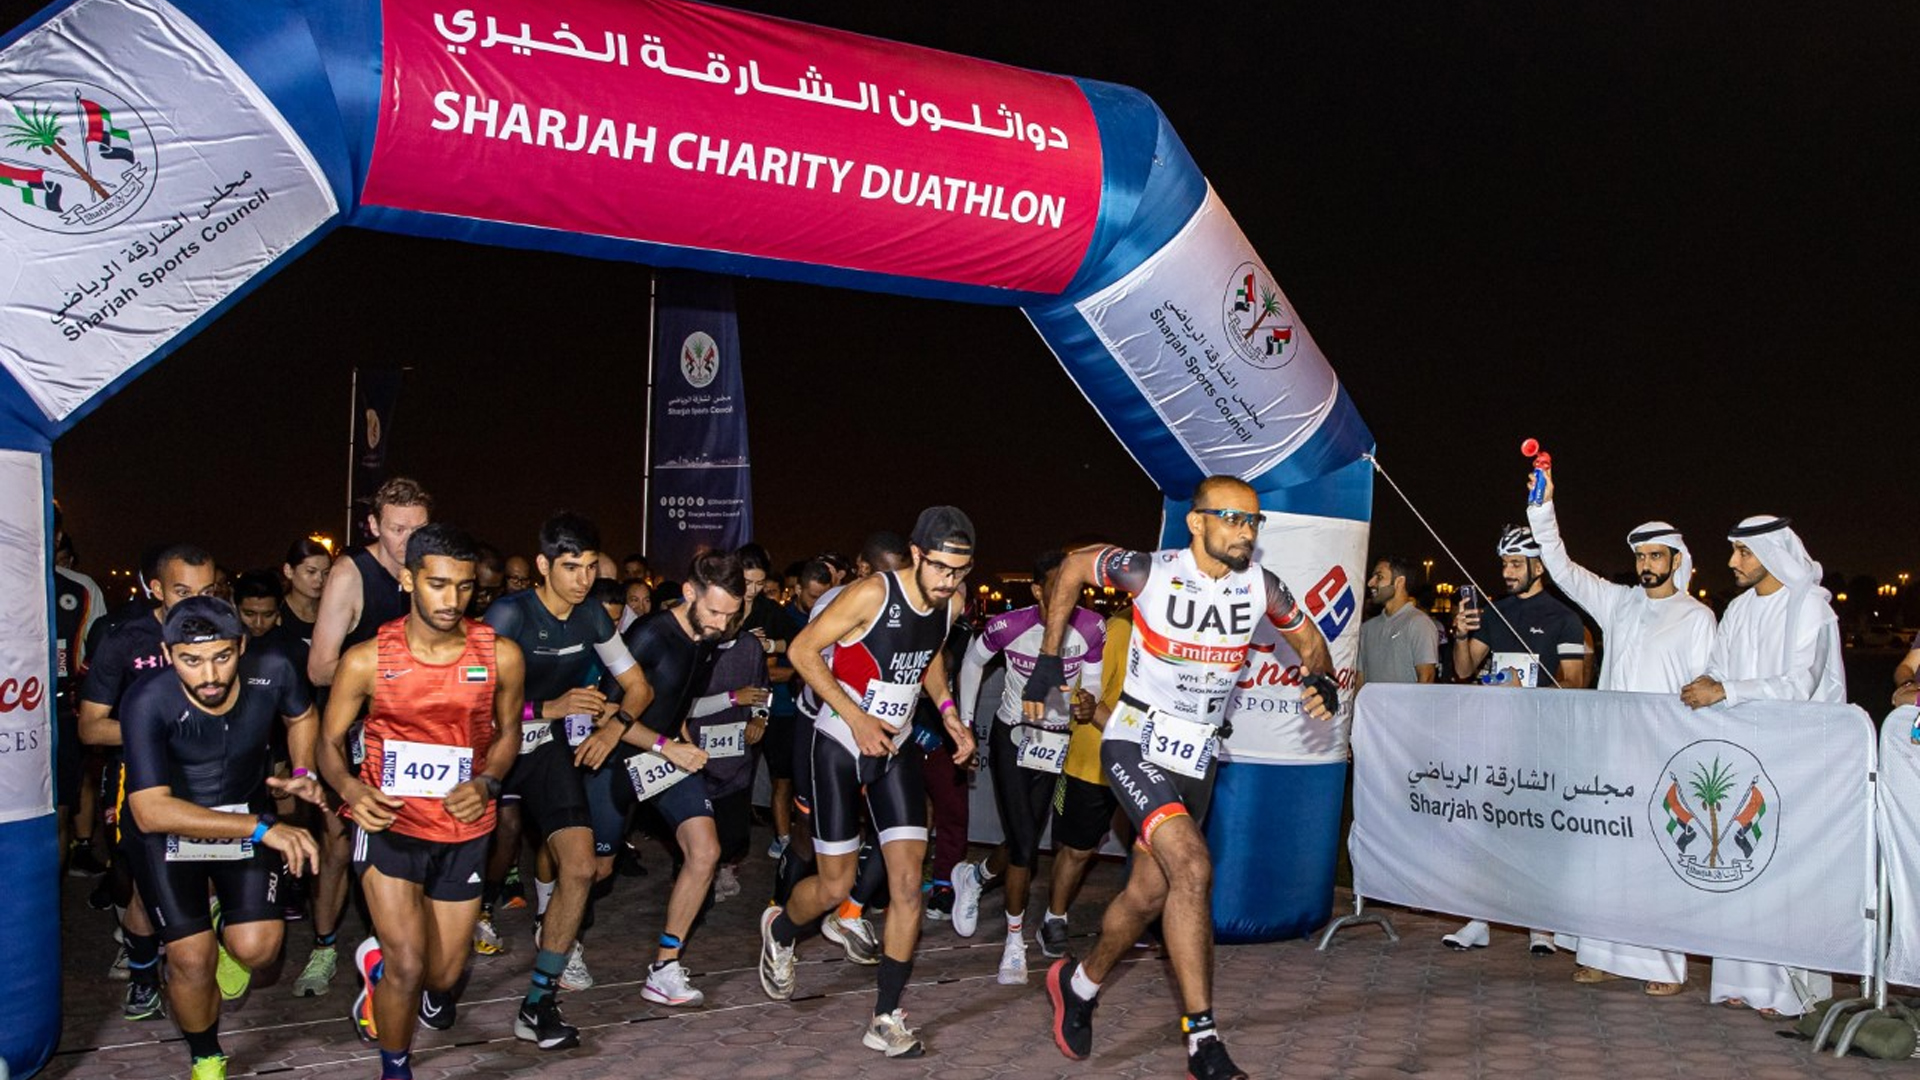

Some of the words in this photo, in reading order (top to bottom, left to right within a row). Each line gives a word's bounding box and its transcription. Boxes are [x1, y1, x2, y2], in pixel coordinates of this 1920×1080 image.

[433, 9, 629, 67] الخيري
[640, 34, 880, 114] الشارقة
[889, 89, 1069, 151] دواثلون
[430, 90, 657, 163] SHARJAH
[668, 132, 854, 194] CHARITY
[860, 163, 1066, 229] DUATHLON
[198, 168, 252, 219] مجلس
[121, 211, 190, 264] الشارقة
[63, 286, 138, 342] Sharjah
[137, 242, 200, 289] Sports
[200, 187, 270, 242] Council
[50, 260, 122, 326] الرياضي
[1150, 308, 1187, 357] Sharjah
[1185, 356, 1217, 397] Sports
[1214, 396, 1253, 442] Council
[1166, 594, 1251, 635] UAE
[1167, 641, 1244, 663] Emirates
[875, 701, 909, 716] 335
[710, 736, 734, 748] 341
[1029, 746, 1056, 760] 402
[1156, 735, 1195, 760] 318
[1195, 737, 1216, 772] SPRINT
[382, 751, 396, 788] SPRINT
[403, 762, 450, 781] 407
[458, 757, 472, 783] SPRIN
[645, 761, 676, 784] 330
[1110, 762, 1149, 811] EMAAR
[1138, 761, 1165, 784] UAE
[1407, 761, 1478, 789] الرياضي
[1485, 765, 1555, 795] الشارقة
[1562, 775, 1635, 804] مجلس
[1409, 792, 1478, 822] Sharjah
[1482, 802, 1544, 829] Sports
[1551, 809, 1634, 838] Council
[267, 872, 279, 904] 2XU
